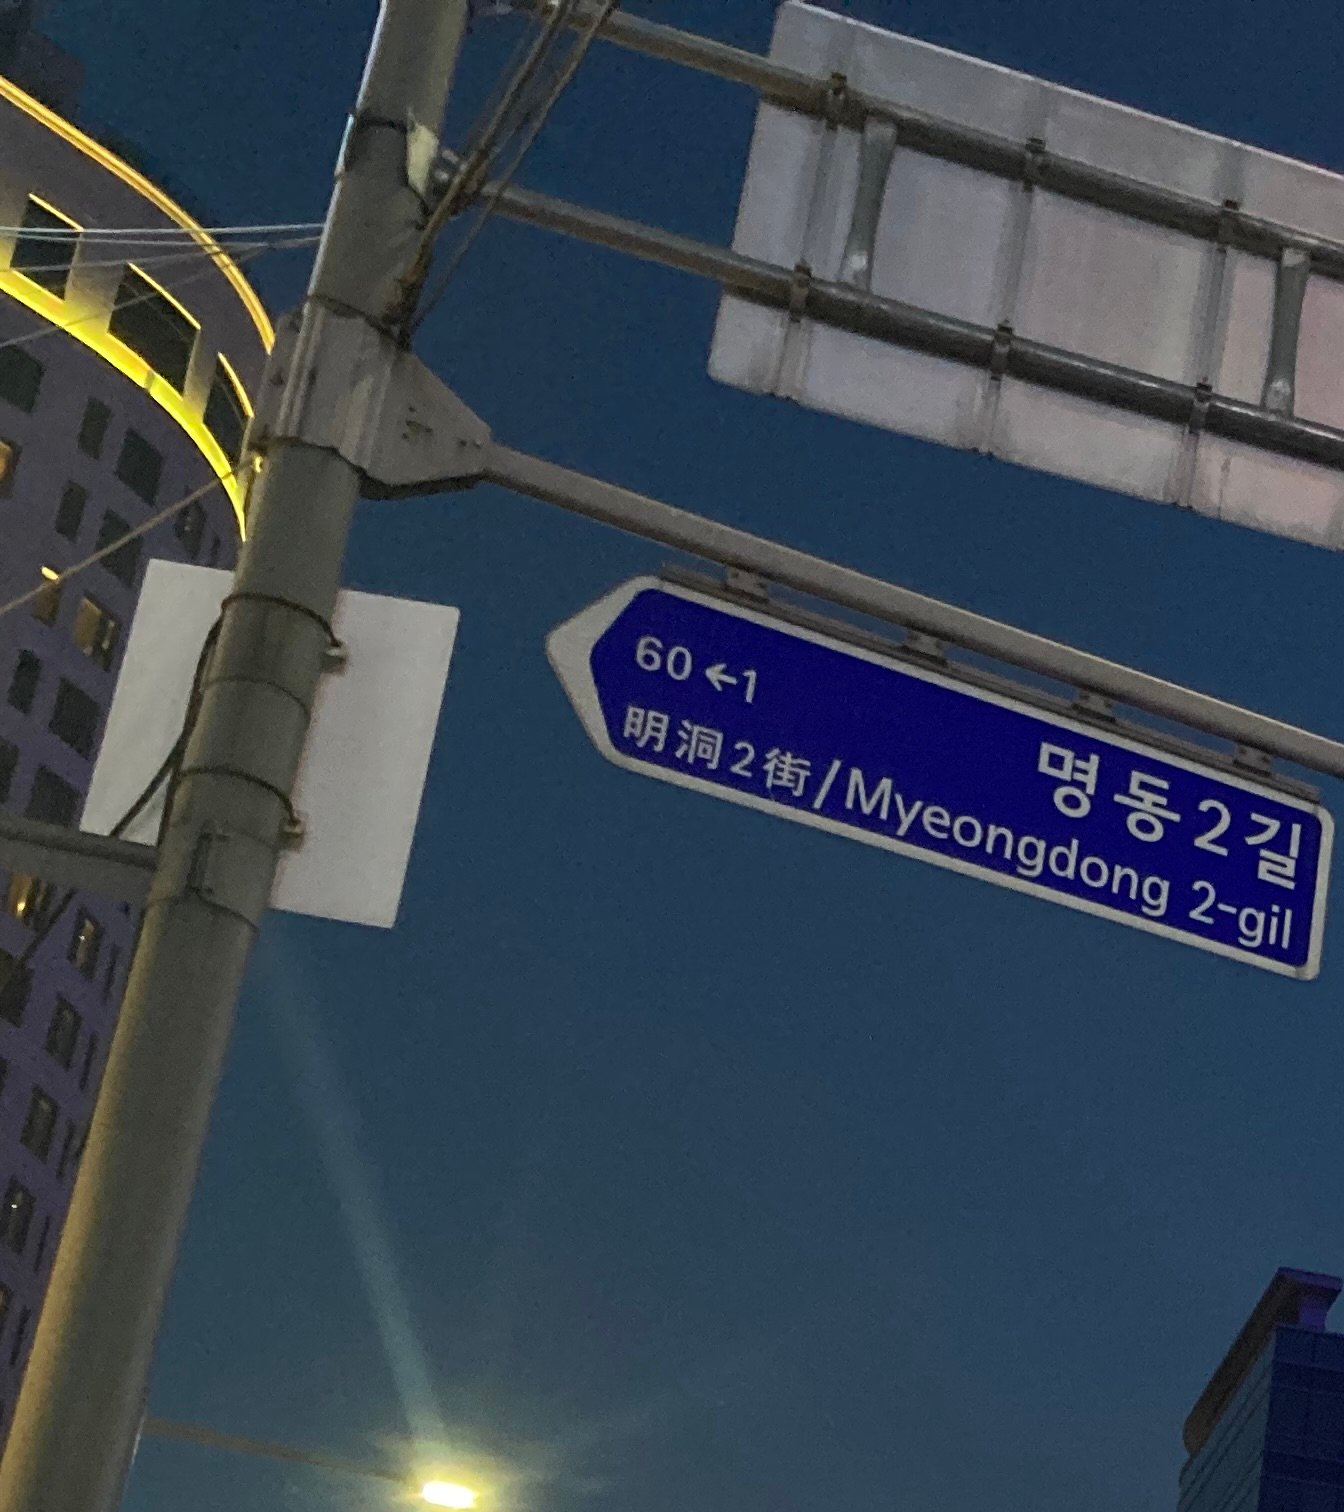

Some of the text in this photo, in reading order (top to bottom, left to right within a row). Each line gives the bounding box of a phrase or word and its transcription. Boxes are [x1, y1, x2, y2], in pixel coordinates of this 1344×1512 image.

[635, 636, 692, 681] 60
[1038, 742, 1301, 891] 명동2길
[1188, 880, 1293, 951] 2-gil
